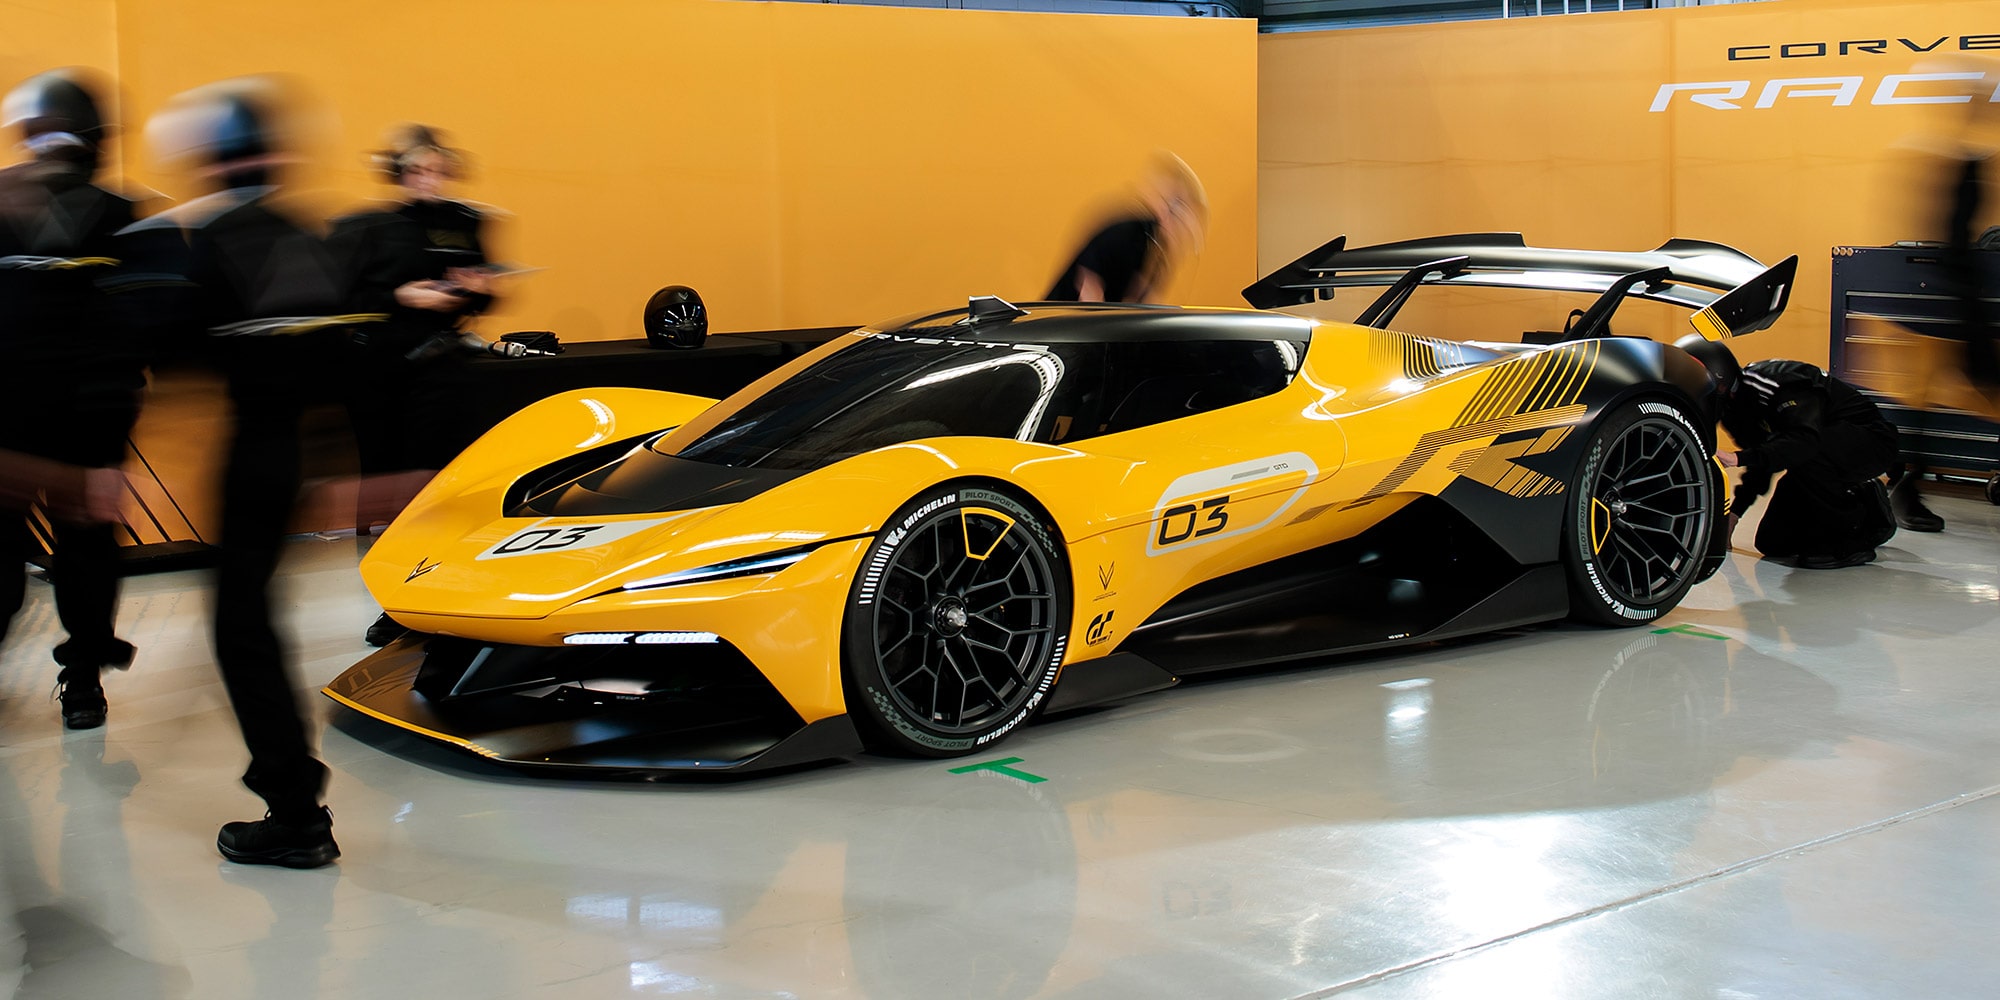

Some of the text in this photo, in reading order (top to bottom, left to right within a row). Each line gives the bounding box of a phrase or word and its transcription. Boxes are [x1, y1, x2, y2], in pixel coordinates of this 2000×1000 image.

[1728, 34, 2000, 61] CORVE
[852, 329, 1050, 352] ORVETTE
[903, 493, 956, 530] MICHELIN
[965, 491, 1017, 509] PILOT SPORT
[1158, 495, 1230, 546] 03
[492, 525, 606, 554] 03
[1585, 562, 1614, 605] MICHELIN
[976, 708, 1027, 745] MICHELIN
